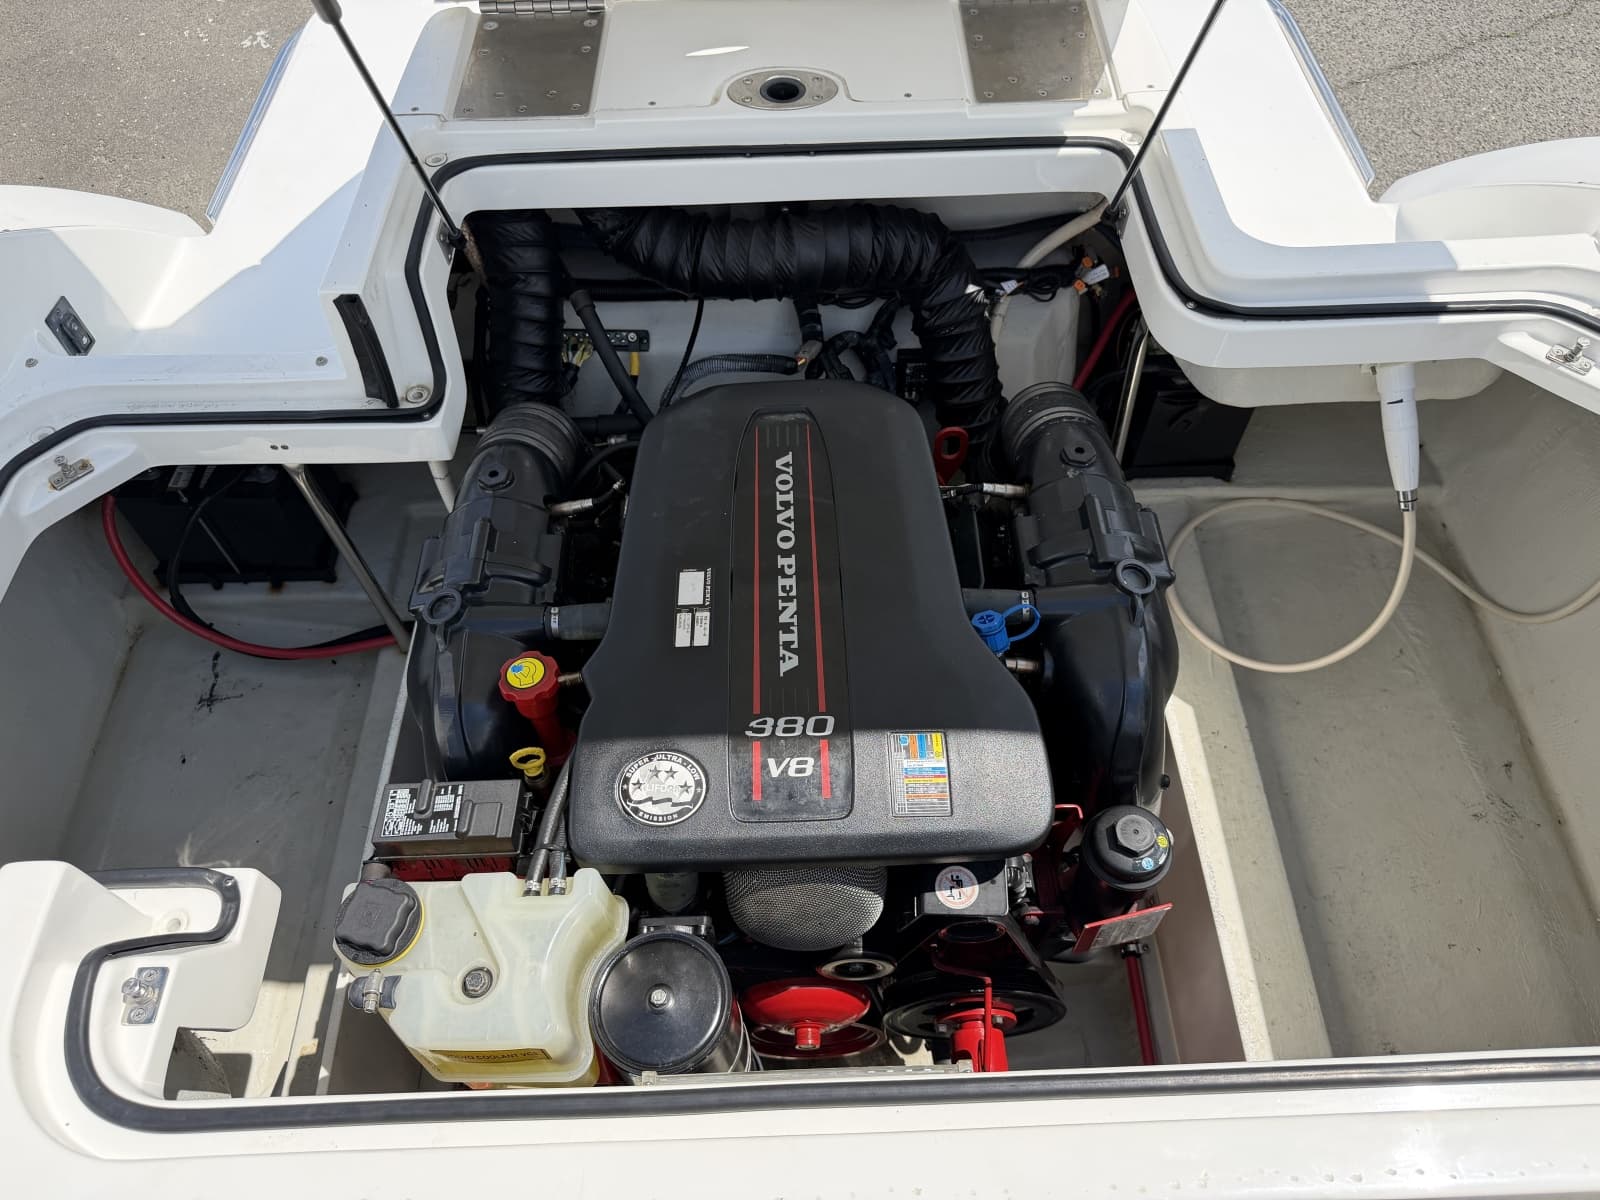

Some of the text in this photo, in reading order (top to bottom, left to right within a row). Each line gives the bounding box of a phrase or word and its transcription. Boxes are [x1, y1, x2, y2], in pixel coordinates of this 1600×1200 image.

[775, 451, 799, 677] VOLVO PENTA
[744, 715, 835, 737] 380
[626, 754, 701, 781] SUPER ULTRA LOW
[767, 756, 815, 778] V8
[639, 811, 678, 821] EMISSION
